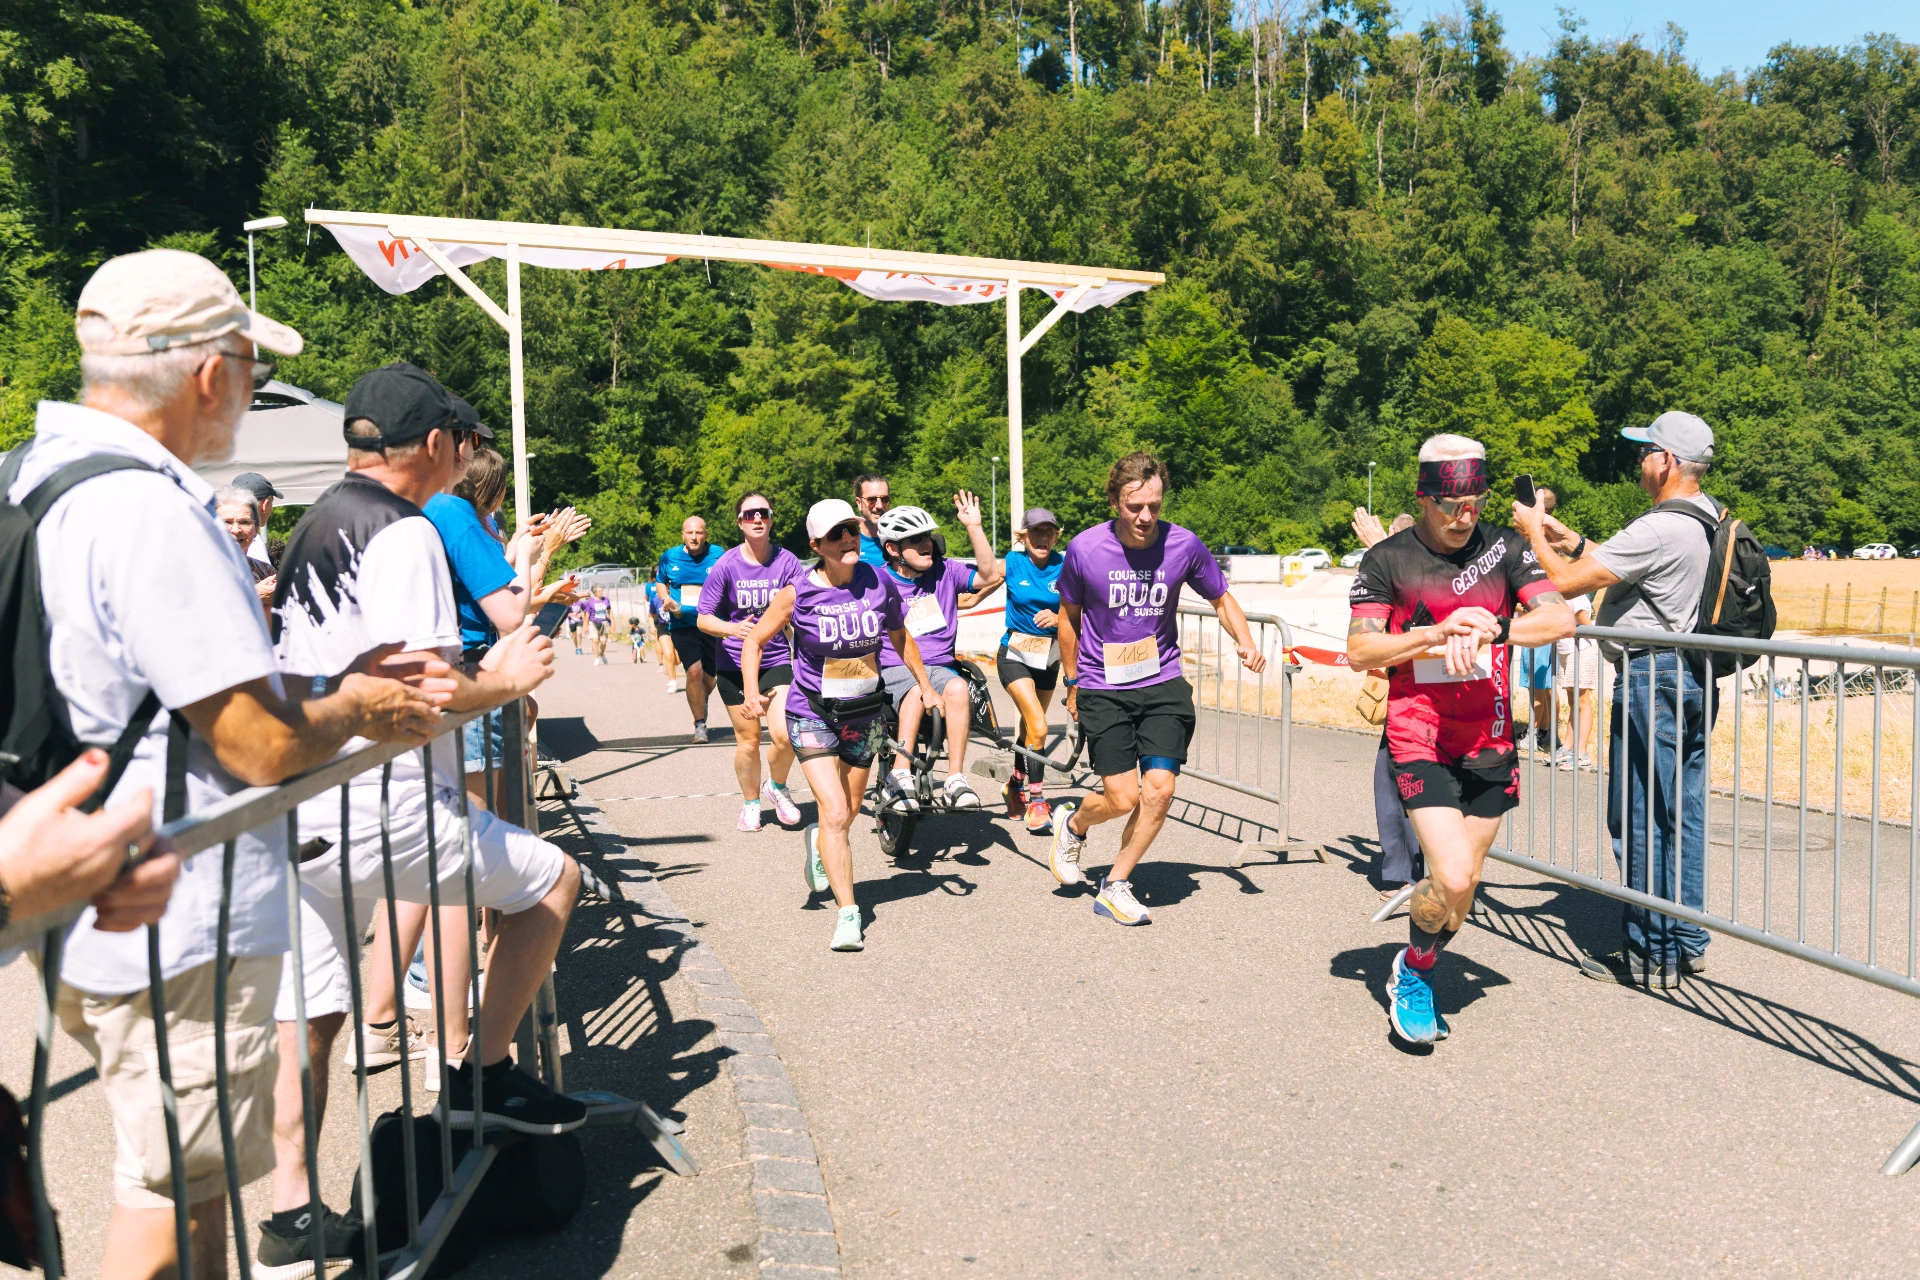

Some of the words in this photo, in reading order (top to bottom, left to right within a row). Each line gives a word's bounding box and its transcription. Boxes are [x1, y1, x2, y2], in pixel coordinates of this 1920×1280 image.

[1439, 458, 1480, 479] CAP
[1108, 569, 1152, 580] COURSE
[1452, 565, 1478, 595] CAP
[1477, 536, 1507, 574] HUNT
[736, 579, 769, 588] COURSE
[1109, 582, 1168, 609] DUO
[815, 602, 858, 614] COURSE
[1134, 607, 1165, 617] SUISSE
[818, 610, 879, 643] DUO
[849, 638, 879, 648] SUISSE
[1118, 642, 1149, 663] 118
[840, 660, 871, 676] 118
[1401, 779, 1424, 800] UNT
